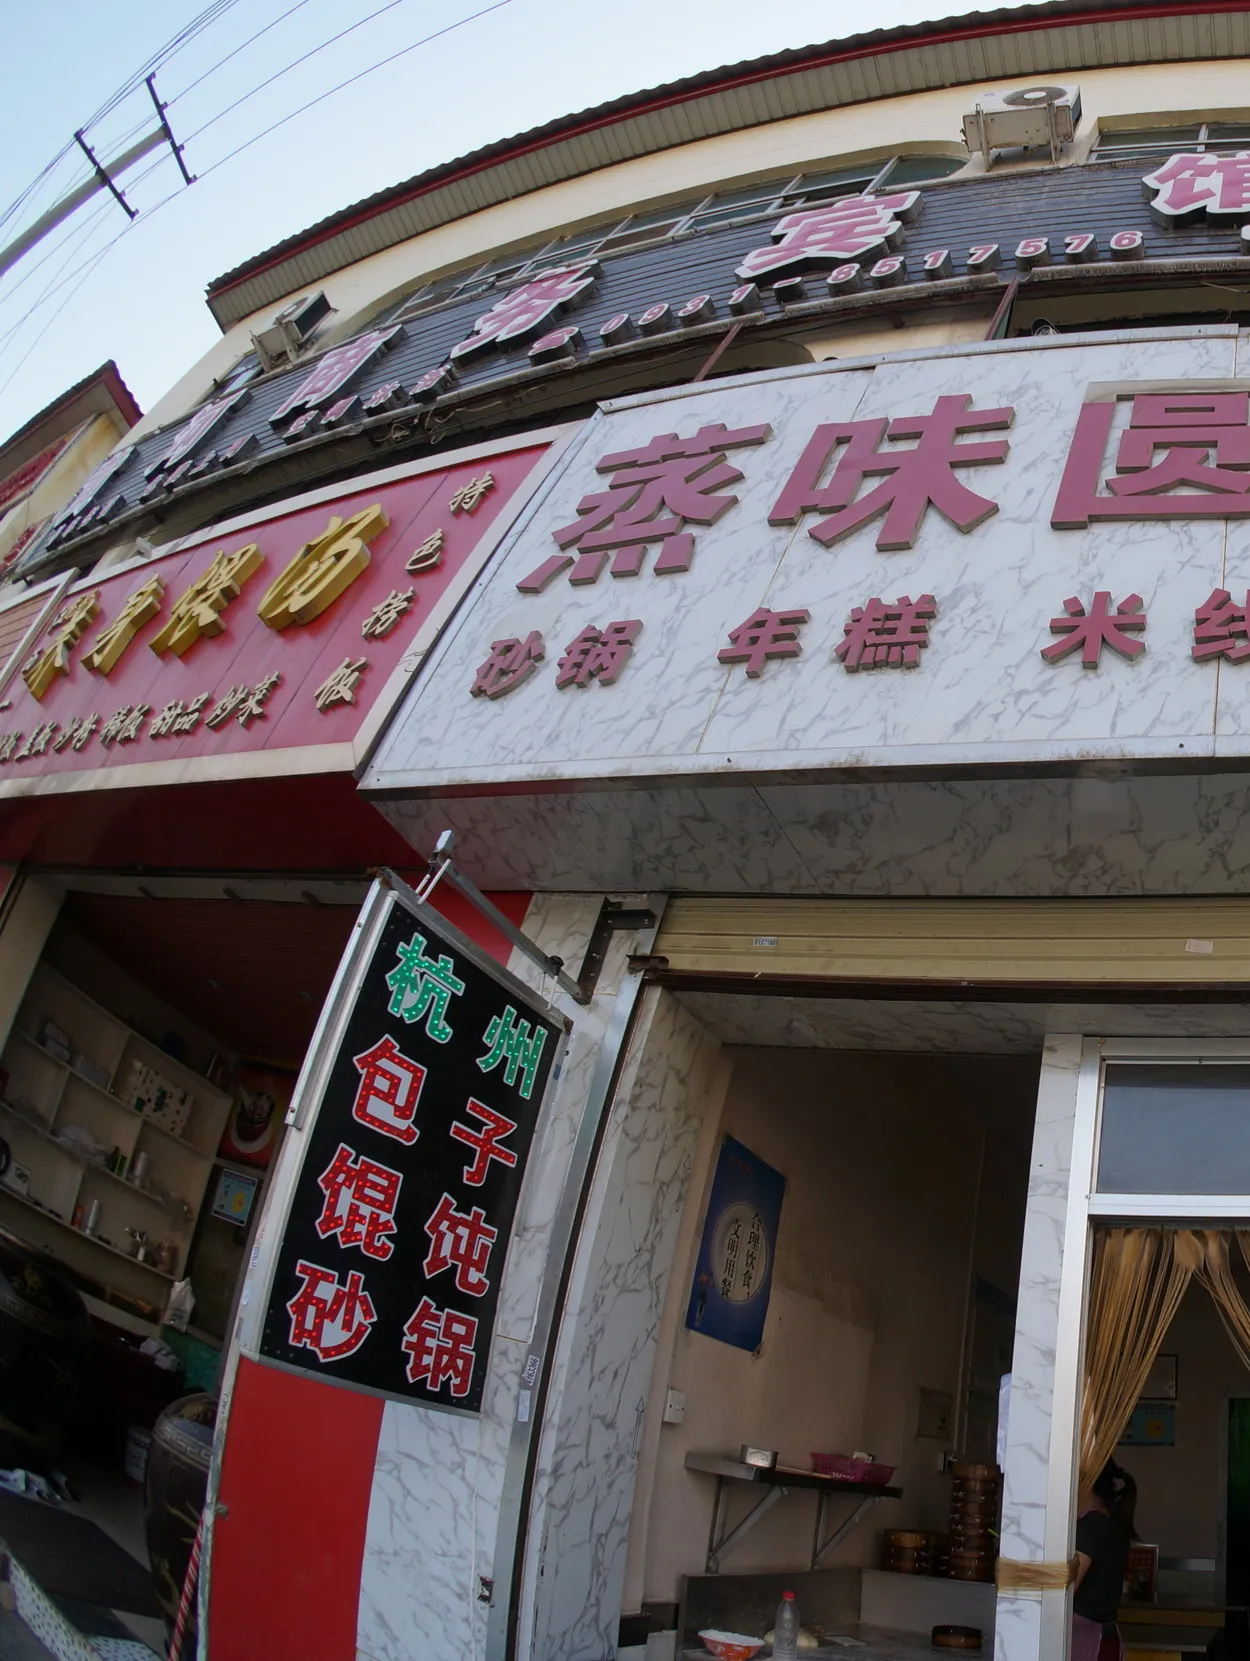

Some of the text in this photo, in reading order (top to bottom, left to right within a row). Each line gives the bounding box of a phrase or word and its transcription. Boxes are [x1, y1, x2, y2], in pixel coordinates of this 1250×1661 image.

[469, 619, 643, 699] 砂锅
[717, 594, 936, 678] 年糕
[386, 933, 548, 1099] 杭州
[353, 1034, 517, 1187] 包子
[317, 1143, 498, 1297] 馄饨
[287, 1260, 478, 1397] 砂锅
